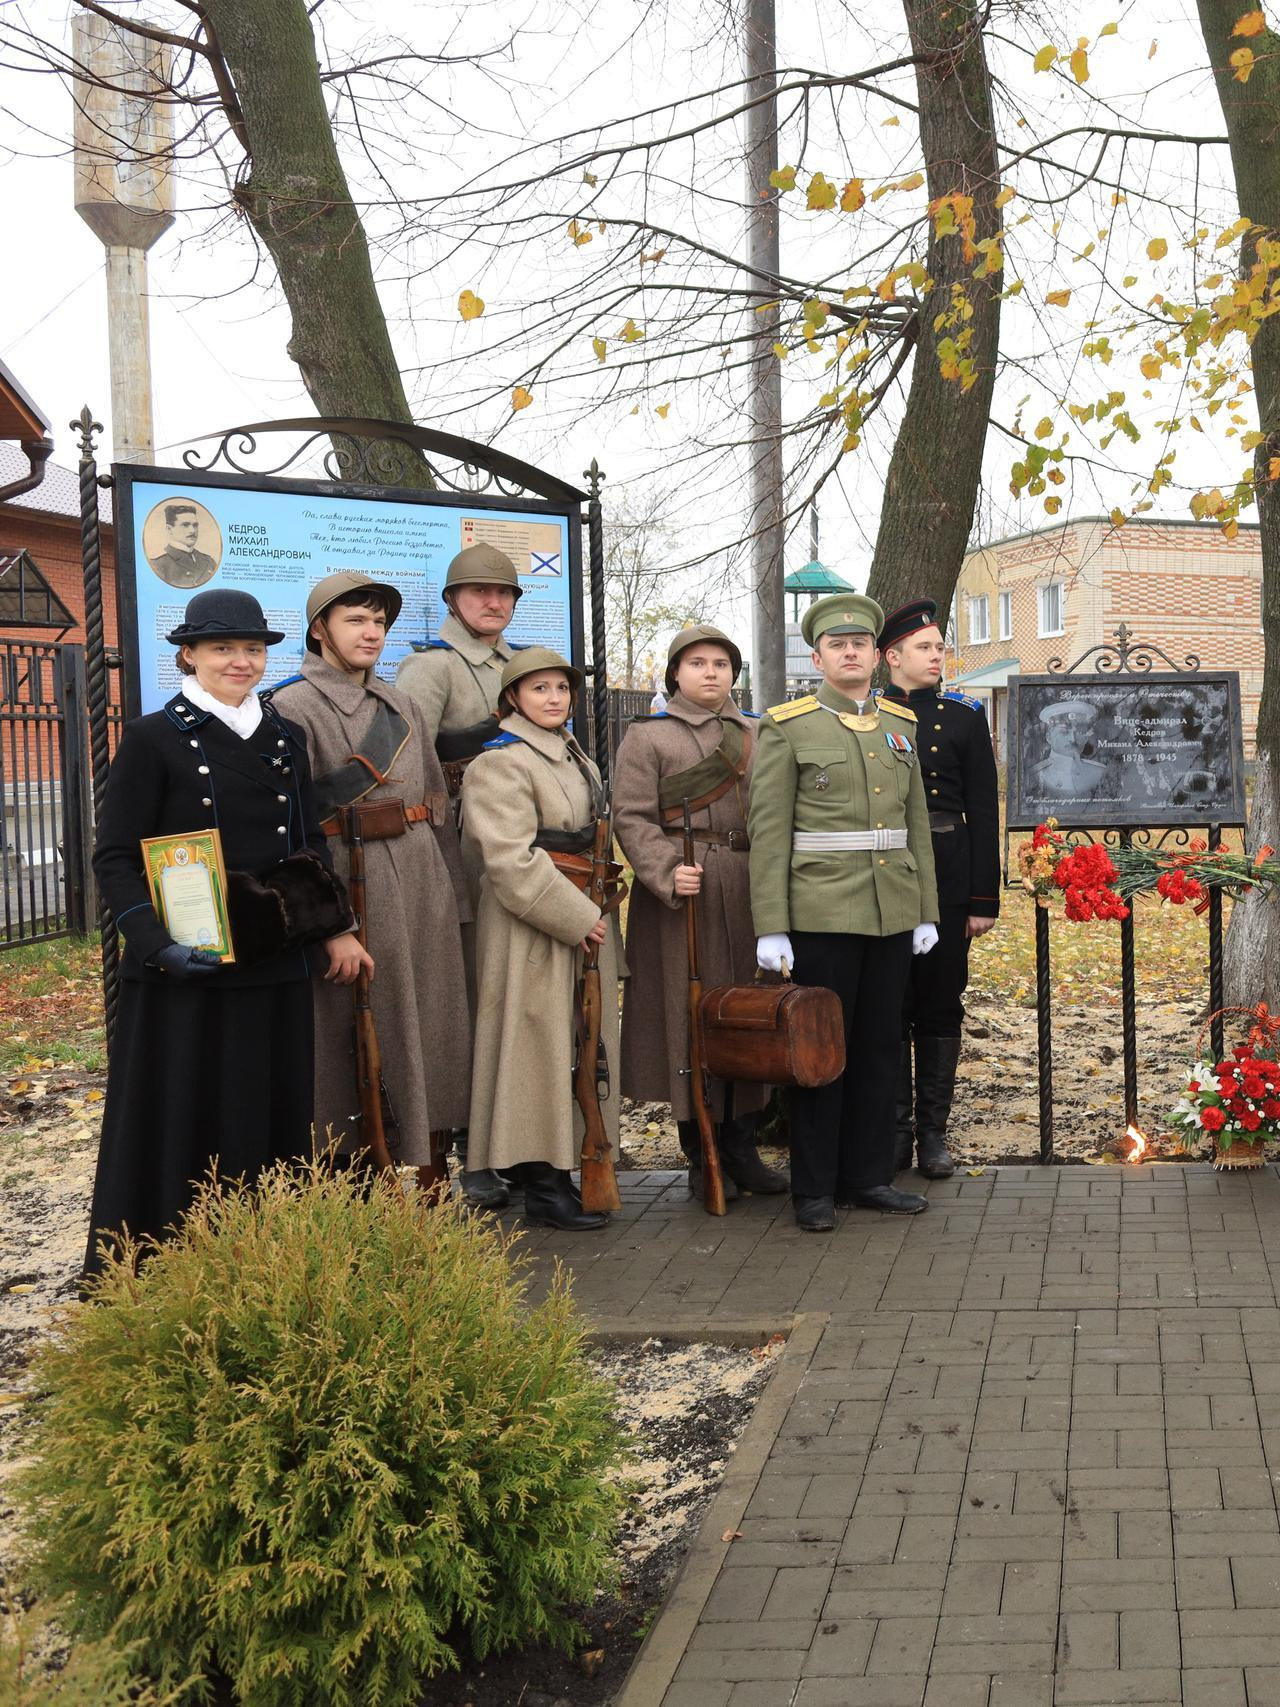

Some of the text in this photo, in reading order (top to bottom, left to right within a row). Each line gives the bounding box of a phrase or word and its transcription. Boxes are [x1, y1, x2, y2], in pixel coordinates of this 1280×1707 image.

[320, 512, 343, 520] слава
[344, 514, 373, 523] русских
[374, 516, 406, 525] моряков
[228, 524, 267, 535] КЕДРОВ
[328, 522, 337, 531] В
[338, 526, 372, 534] историю
[374, 526, 403, 536] вписала
[228, 536, 269, 546] МИХАИЛ
[330, 534, 346, 543] кто
[348, 536, 372, 544] любил
[373, 537, 403, 546] Россию
[229, 547, 311, 560] АЛЕКСАНДРОВИЧ
[371, 569, 393, 577] между
[1113, 715, 1188, 727] Вице-адмирал
[1133, 728, 1166, 738] Кедров
[1097, 739, 1202, 749] Михаил Александрович
[1121, 753, 1144, 762] 1878
[1155, 753, 1177, 762] 1945
